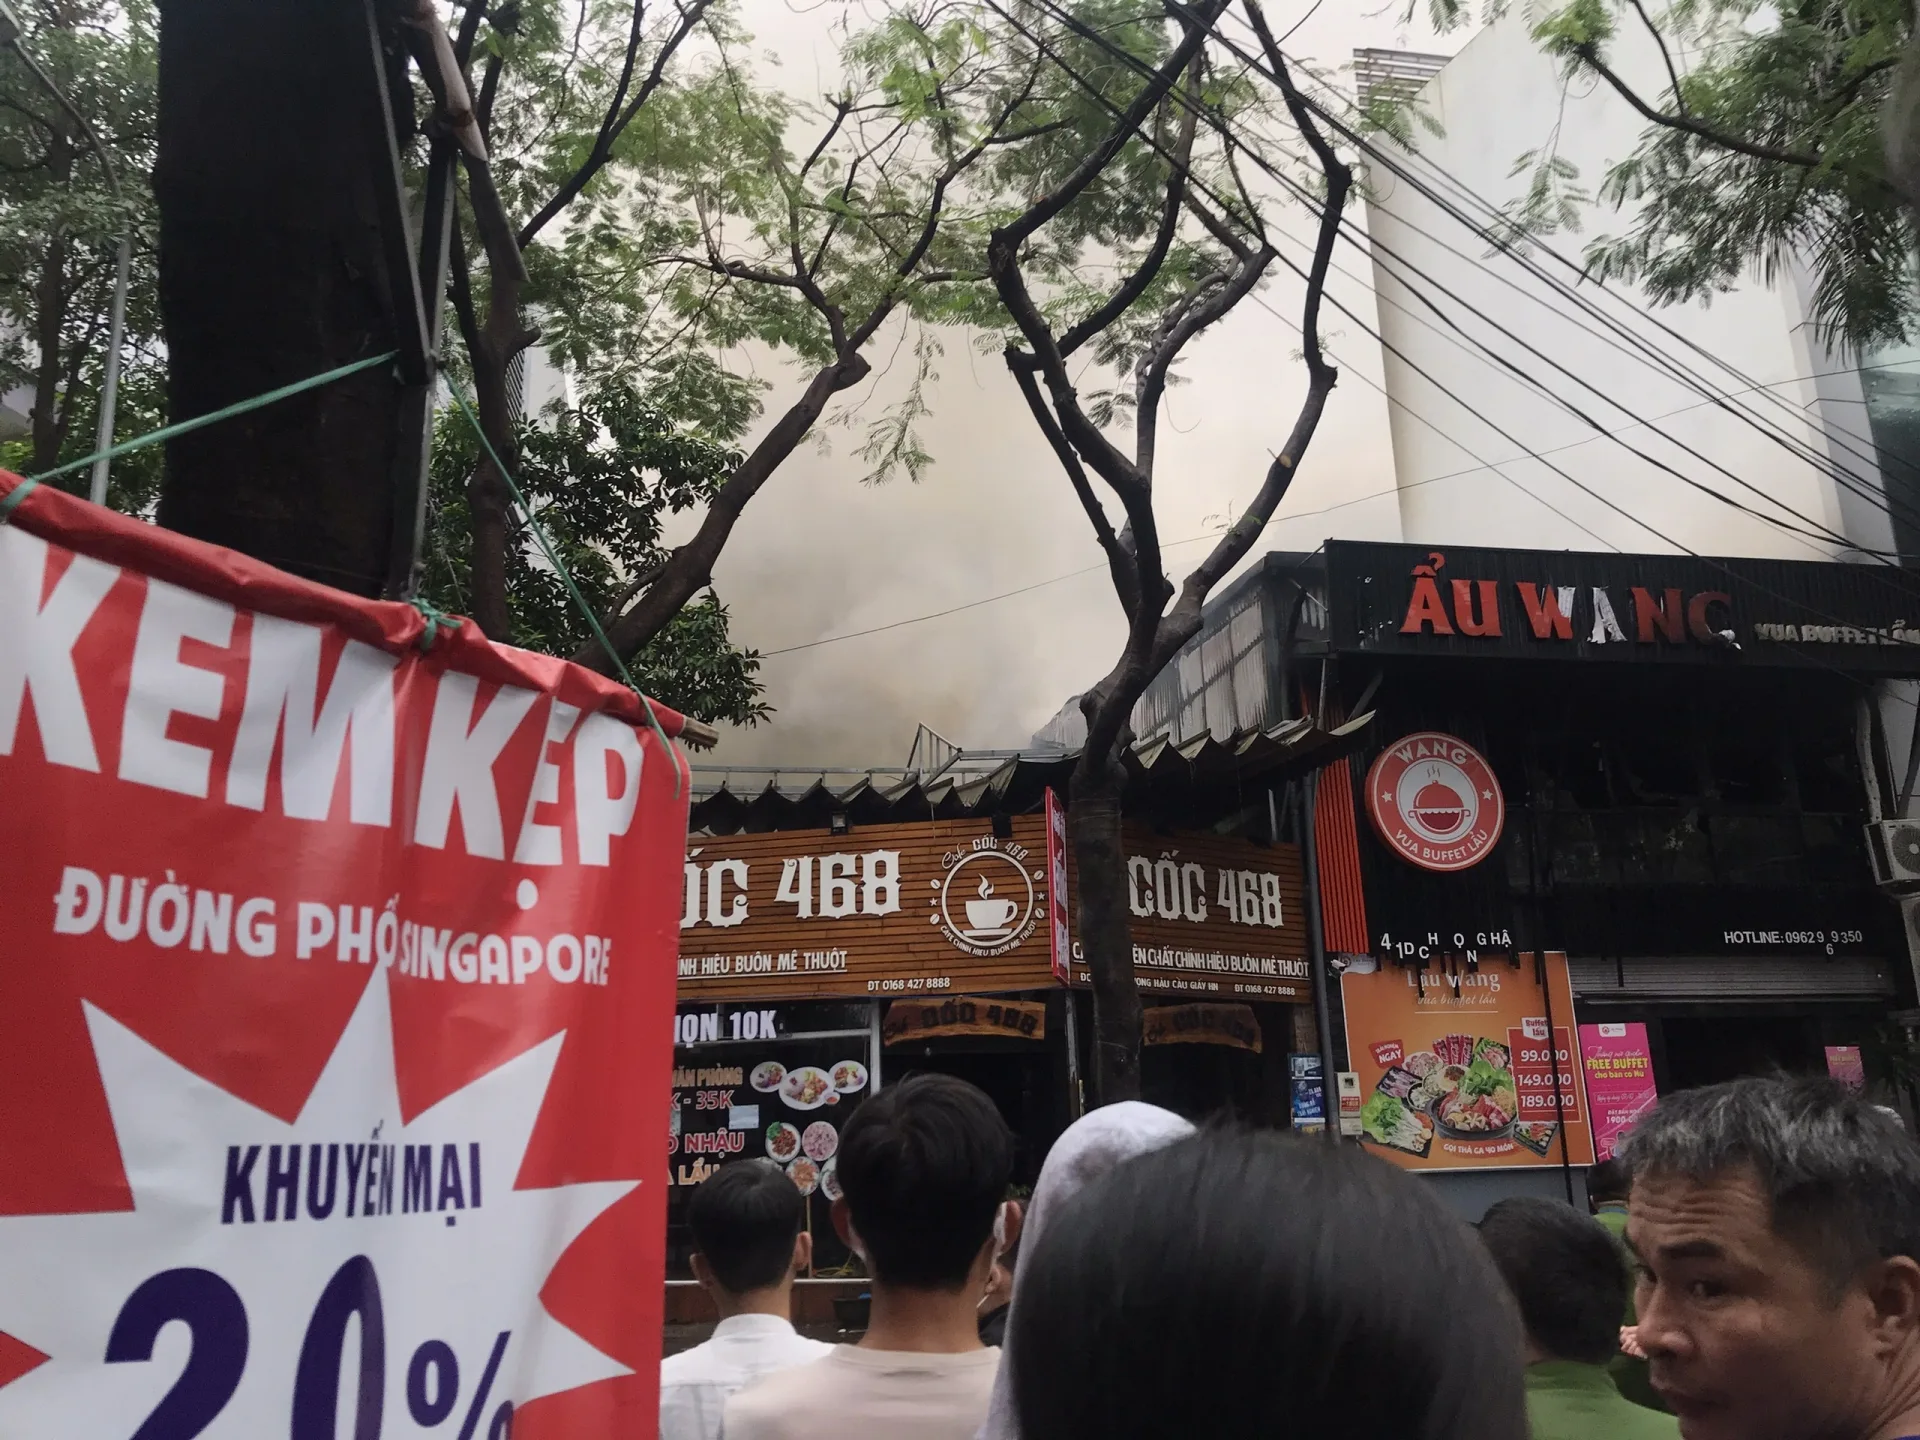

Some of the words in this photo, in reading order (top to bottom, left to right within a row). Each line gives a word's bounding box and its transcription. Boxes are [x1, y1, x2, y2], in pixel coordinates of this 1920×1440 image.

[0, 522, 402, 828] KEM
[413, 669, 644, 910] KẸP
[1395, 740, 1468, 765] WANG
[941, 842, 966, 869] Cafe
[1004, 841, 1029, 861] 468
[1396, 829, 1419, 854] VUA
[1423, 847, 1467, 861] BUFFET
[773, 848, 903, 920] 468
[1127, 849, 1209, 924] CỐC
[1217, 868, 1285, 929] 468
[53, 865, 278, 958] ĐƯỜNG
[400, 919, 613, 986] SINGAPORE
[701, 953, 730, 977] HIỆU
[735, 951, 773, 973] BUÔN
[777, 949, 798, 971] MÊ
[803, 947, 848, 971] THUỘT
[1175, 948, 1203, 970] CHÍNH
[1231, 955, 1259, 974] BUÔN
[867, 981, 880, 991] ĐT
[882, 980, 904, 990] 0168
[907, 979, 924, 990] 427
[926, 977, 951, 989] 8888
[1208, 983, 1219, 992] HN
[1234, 983, 1244, 993] ĐT
[1245, 984, 1262, 993] 0168
[1263, 986, 1277, 995] 427
[1278, 986, 1296, 996] 8888
[729, 1010, 777, 1040] 10K
[1379, 1049, 1402, 1064] NGAY
[1586, 1059, 1611, 1070] FREE
[1613, 1057, 1648, 1069] BUFFET
[696, 1090, 735, 1110] 35K
[684, 1127, 745, 1159] NHẬU
[221, 1118, 395, 1225] KHUYẾN
[401, 1142, 482, 1227] MẠI
